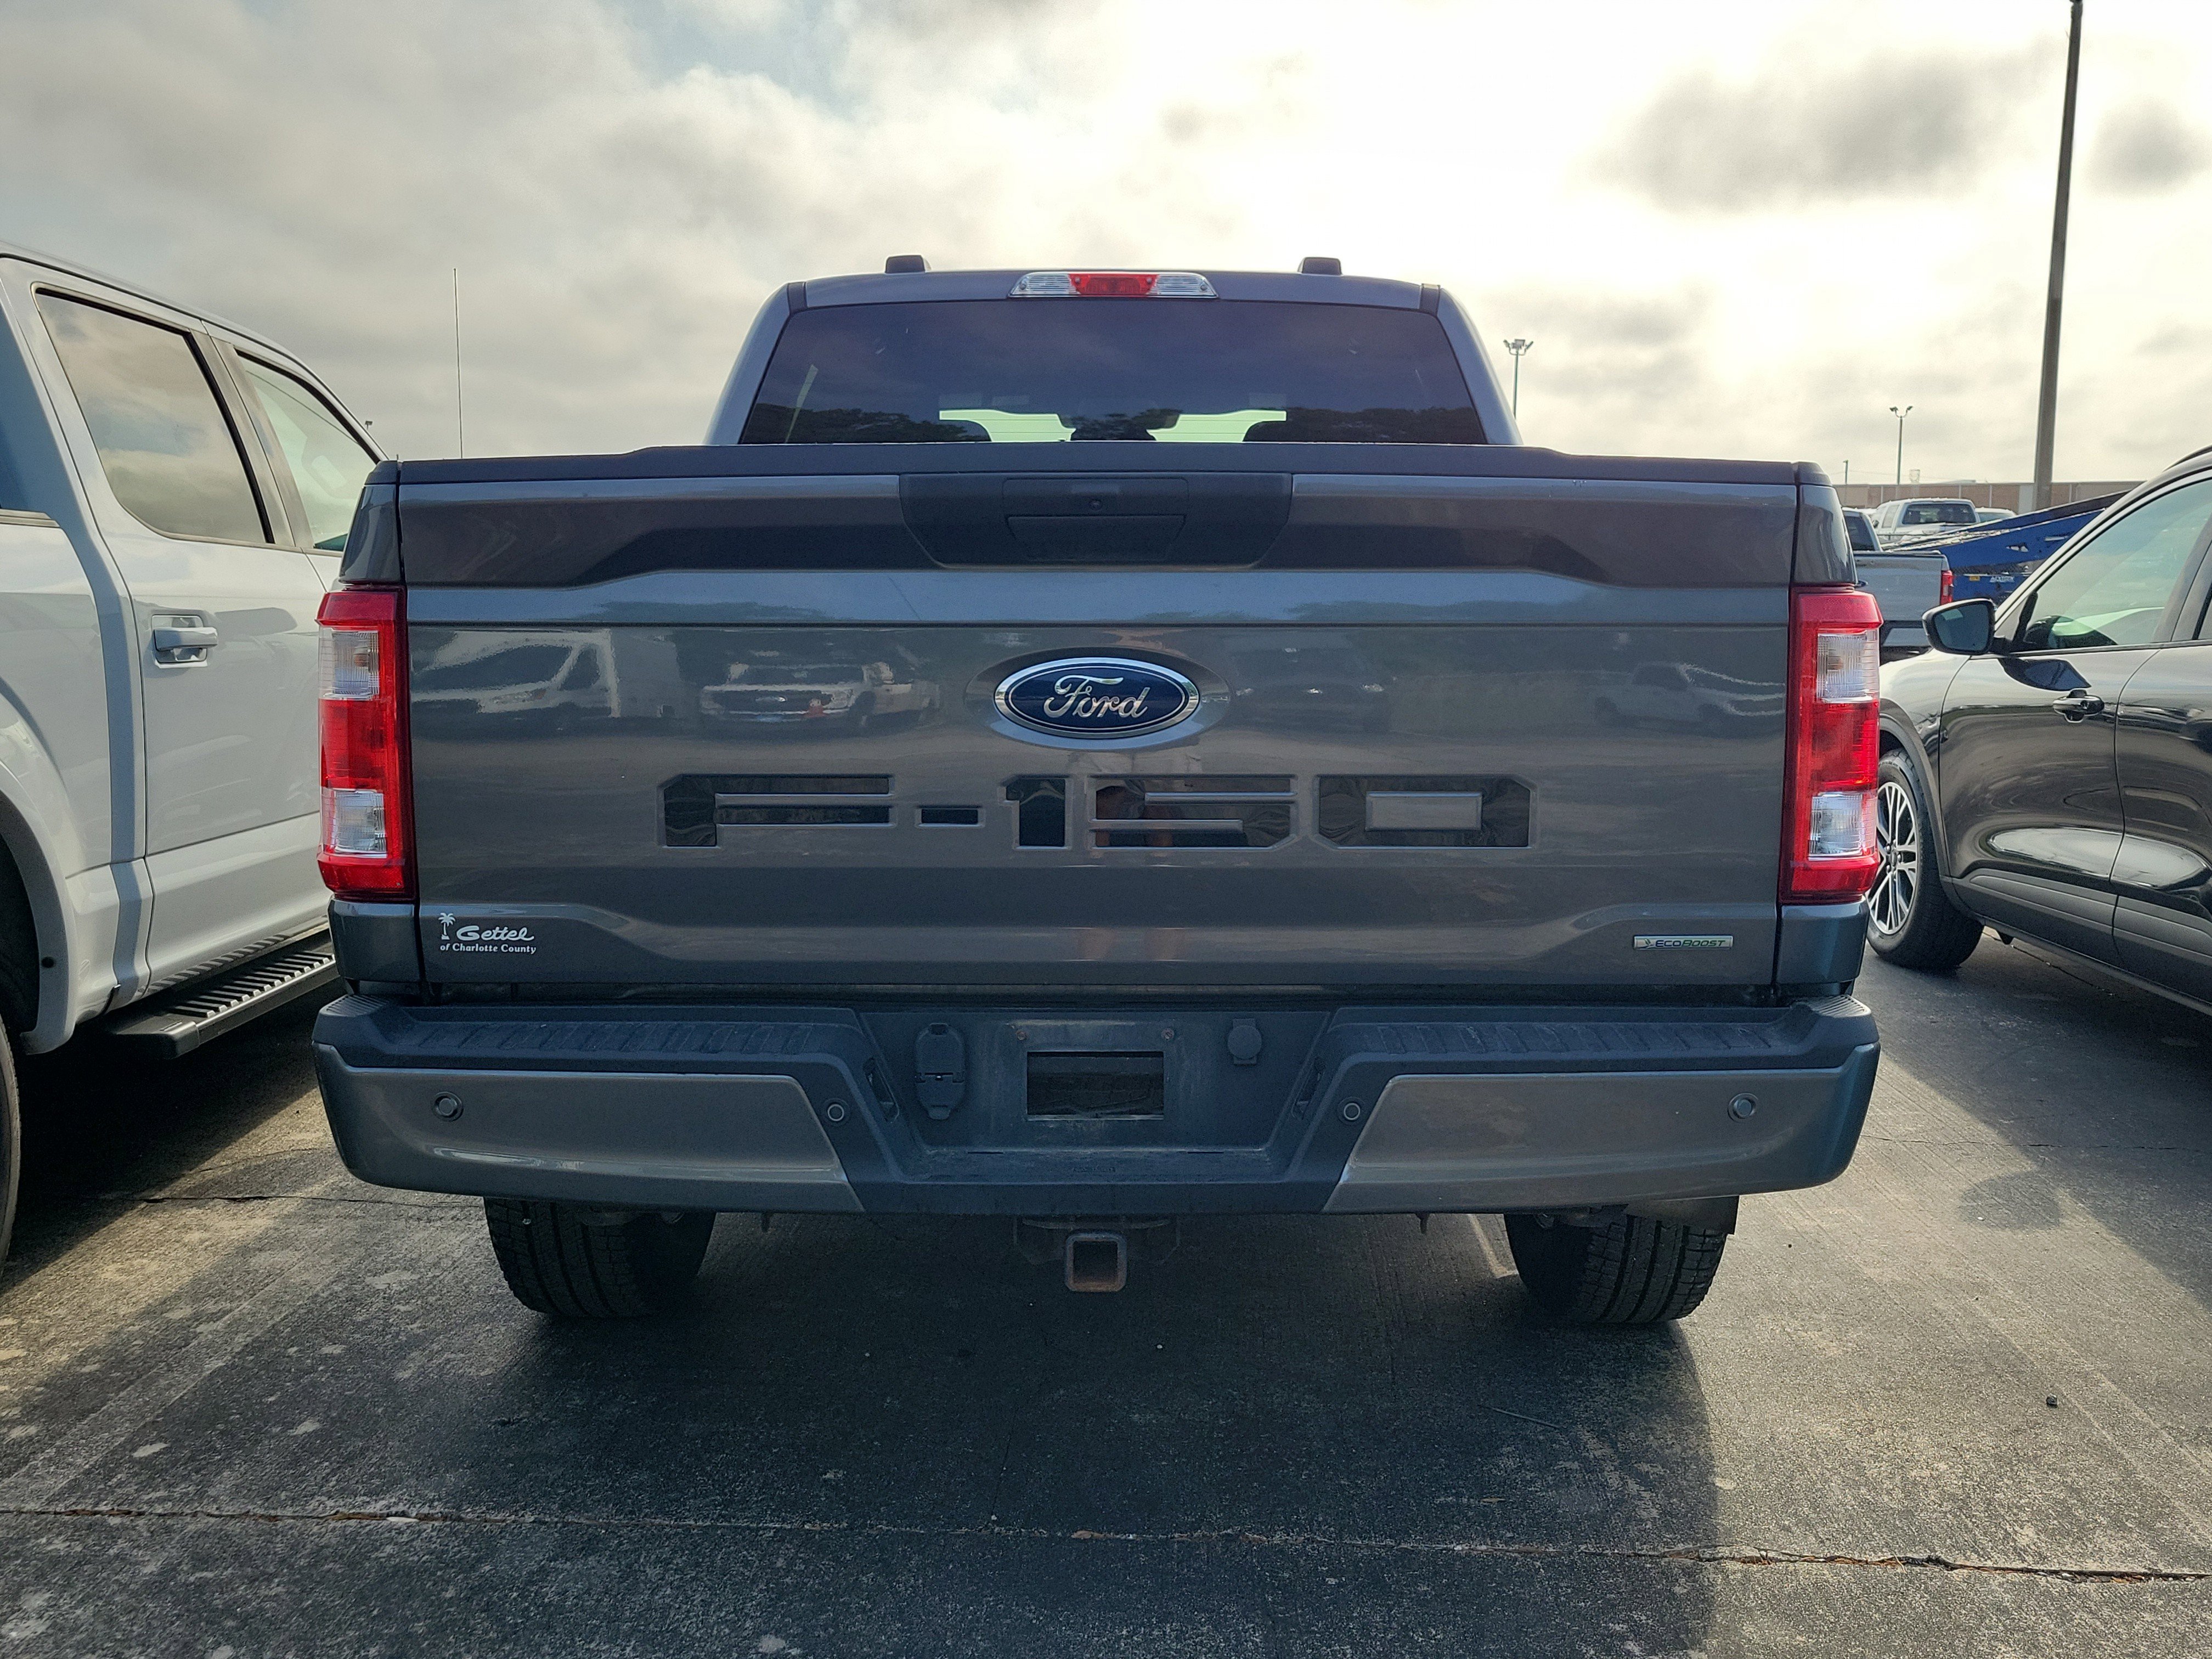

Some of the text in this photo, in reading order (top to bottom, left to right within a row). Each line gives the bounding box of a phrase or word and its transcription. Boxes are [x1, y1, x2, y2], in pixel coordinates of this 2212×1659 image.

[1043, 675, 1150, 718] Ford
[658, 774, 1534, 849] F-150
[456, 925, 535, 941] Gettel
[440, 943, 536, 954] of Charlotte County
